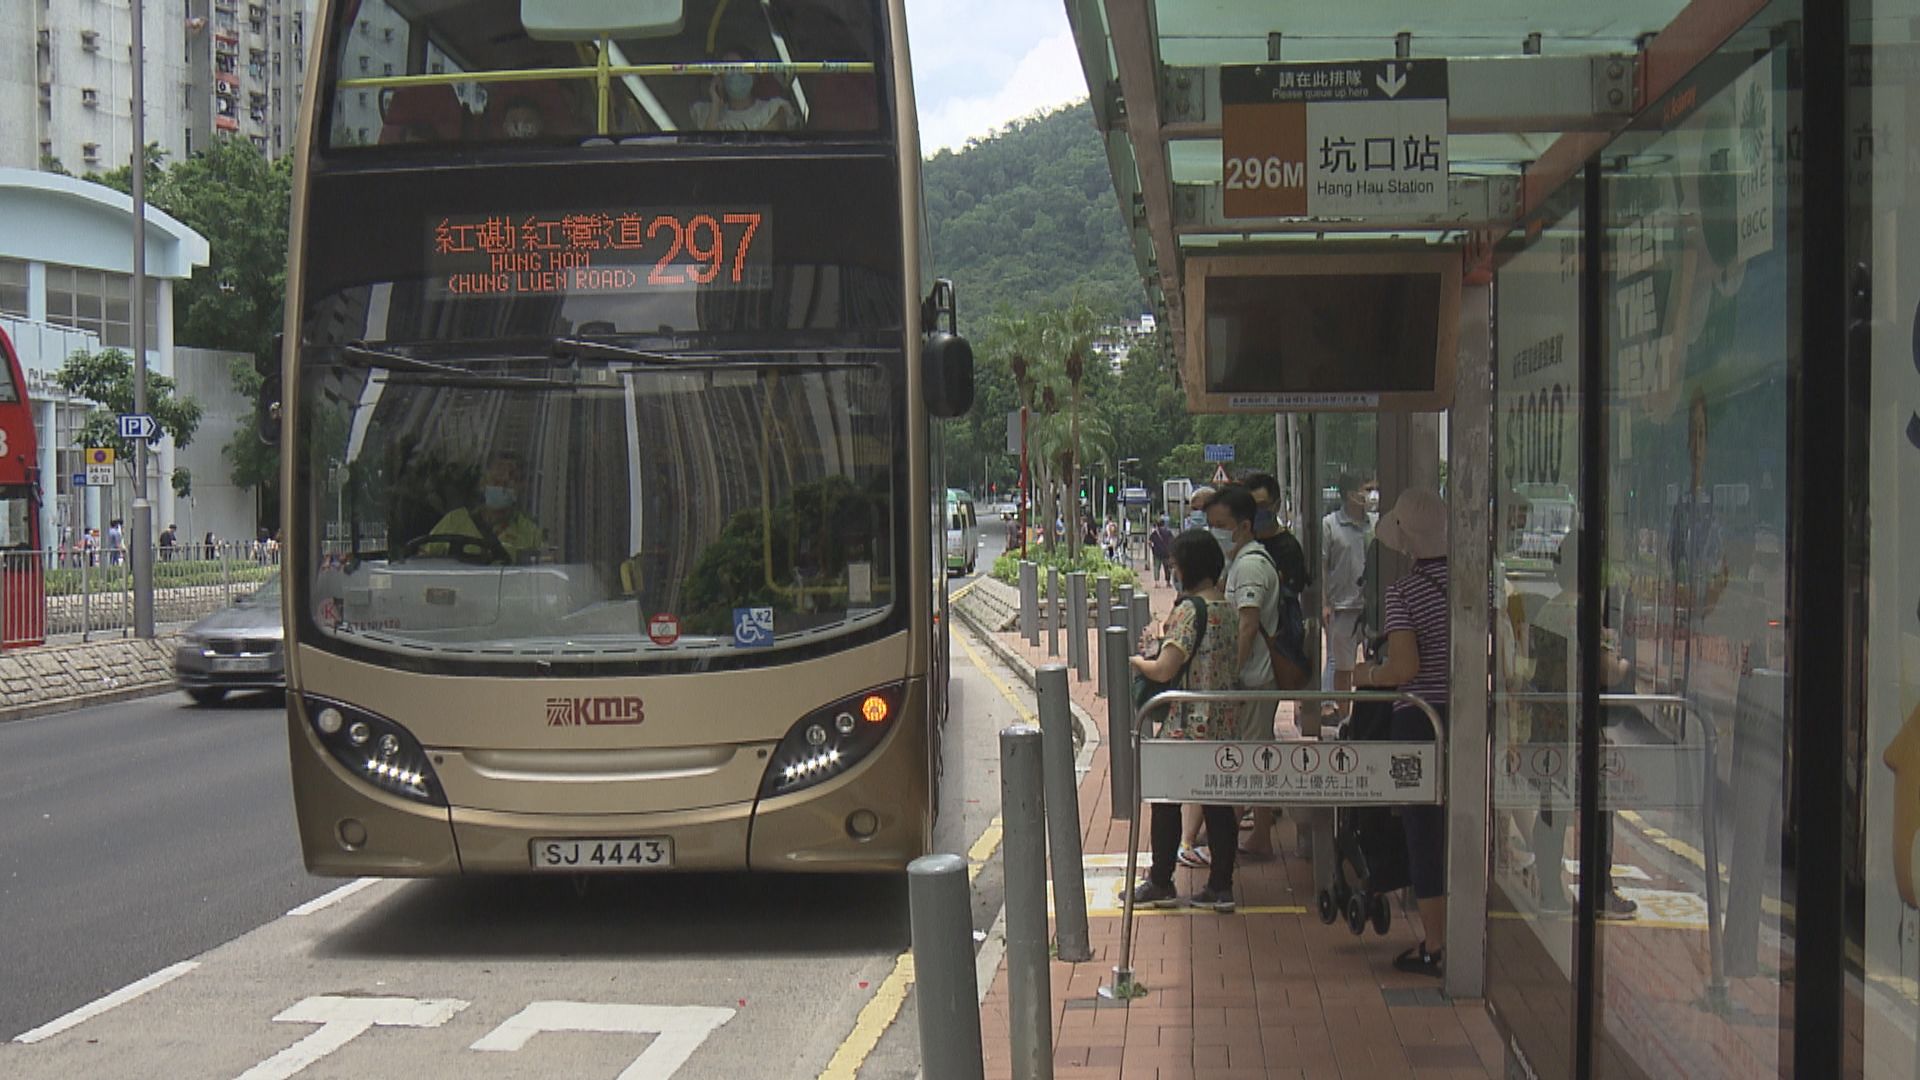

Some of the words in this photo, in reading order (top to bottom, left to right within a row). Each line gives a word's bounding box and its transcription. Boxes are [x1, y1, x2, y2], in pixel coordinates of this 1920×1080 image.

[1279, 69, 1362, 89] 請在此排隊
[1272, 88, 1303, 100] Please
[1334, 88, 1345, 99] up
[1348, 87, 1368, 97] here
[1319, 134, 1440, 174] 坑口站
[1226, 157, 1303, 190] 296M
[1317, 181, 1352, 197] Hang
[1357, 180, 1383, 194] Hau
[1388, 179, 1434, 193] Station
[434, 215, 516, 254] 紅磡
[647, 213, 761, 286] 297
[491, 252, 541, 272] HUNG
[550, 250, 590, 270] HOM
[449, 273, 509, 294] (HUNG
[516, 271, 568, 292] LUEN
[575, 269, 636, 290] ROAD)
[129, 420, 140, 434] P
[756, 610, 772, 623] x2
[574, 696, 645, 726] KMB
[1204, 774, 1369, 789] 請讓有需要人士優先上車
[547, 844, 579, 865] SJ
[591, 842, 660, 864] 4443
